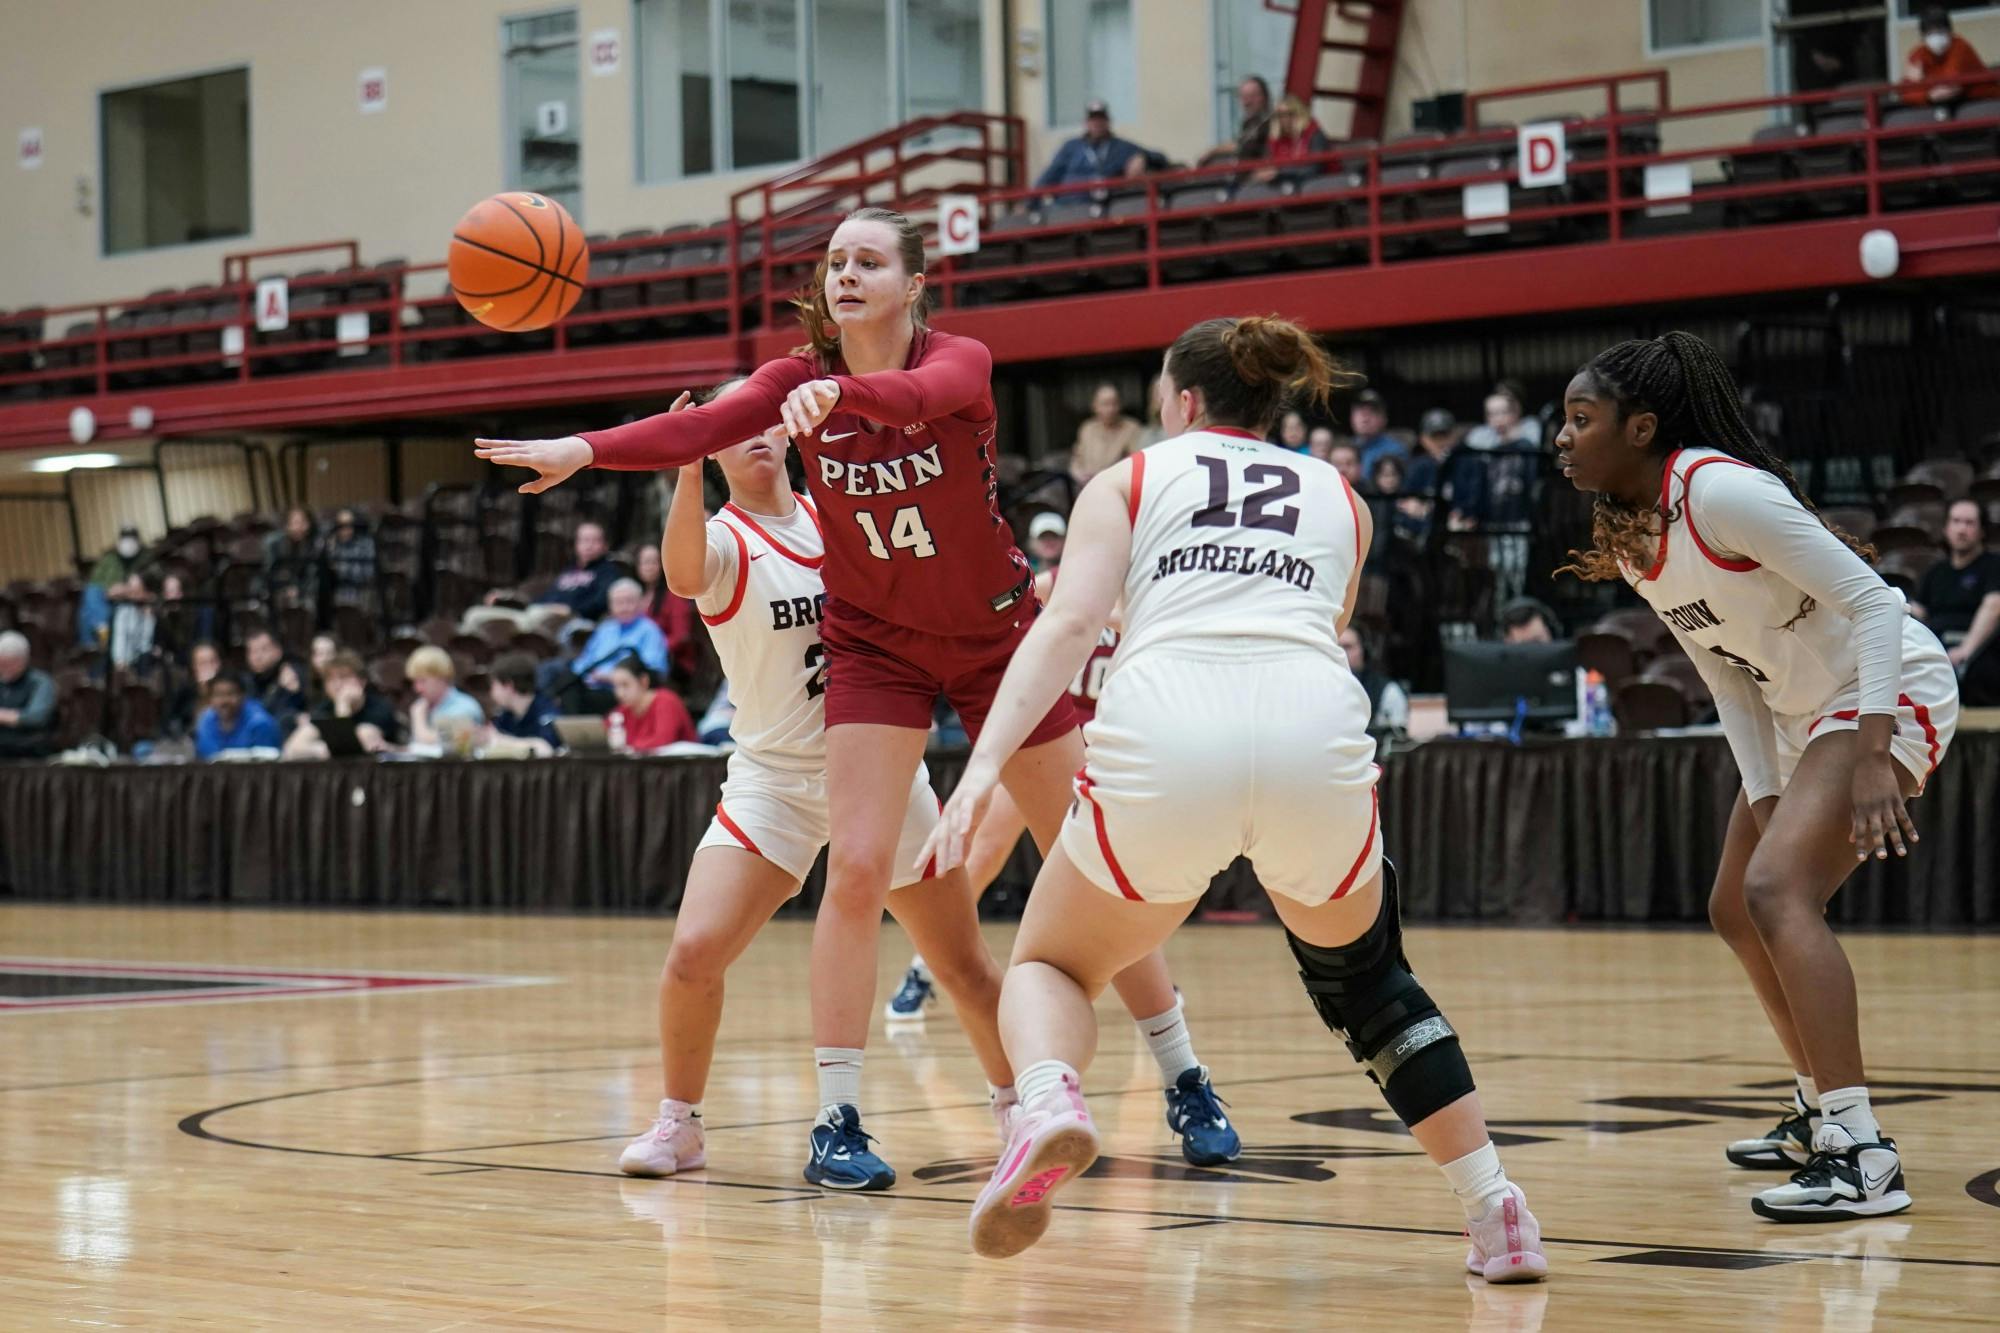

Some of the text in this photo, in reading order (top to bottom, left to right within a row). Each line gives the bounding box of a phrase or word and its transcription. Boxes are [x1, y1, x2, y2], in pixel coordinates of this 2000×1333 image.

[1528, 137, 1556, 174] D
[948, 208, 970, 242] C
[263, 290, 281, 318] A
[817, 443, 944, 496] PENN
[1191, 455, 1301, 537] 12
[854, 504, 938, 560] 14
[1152, 543, 1316, 592] MORELAND
[769, 593, 828, 631] BRO
[1662, 598, 1722, 633] ROWN
